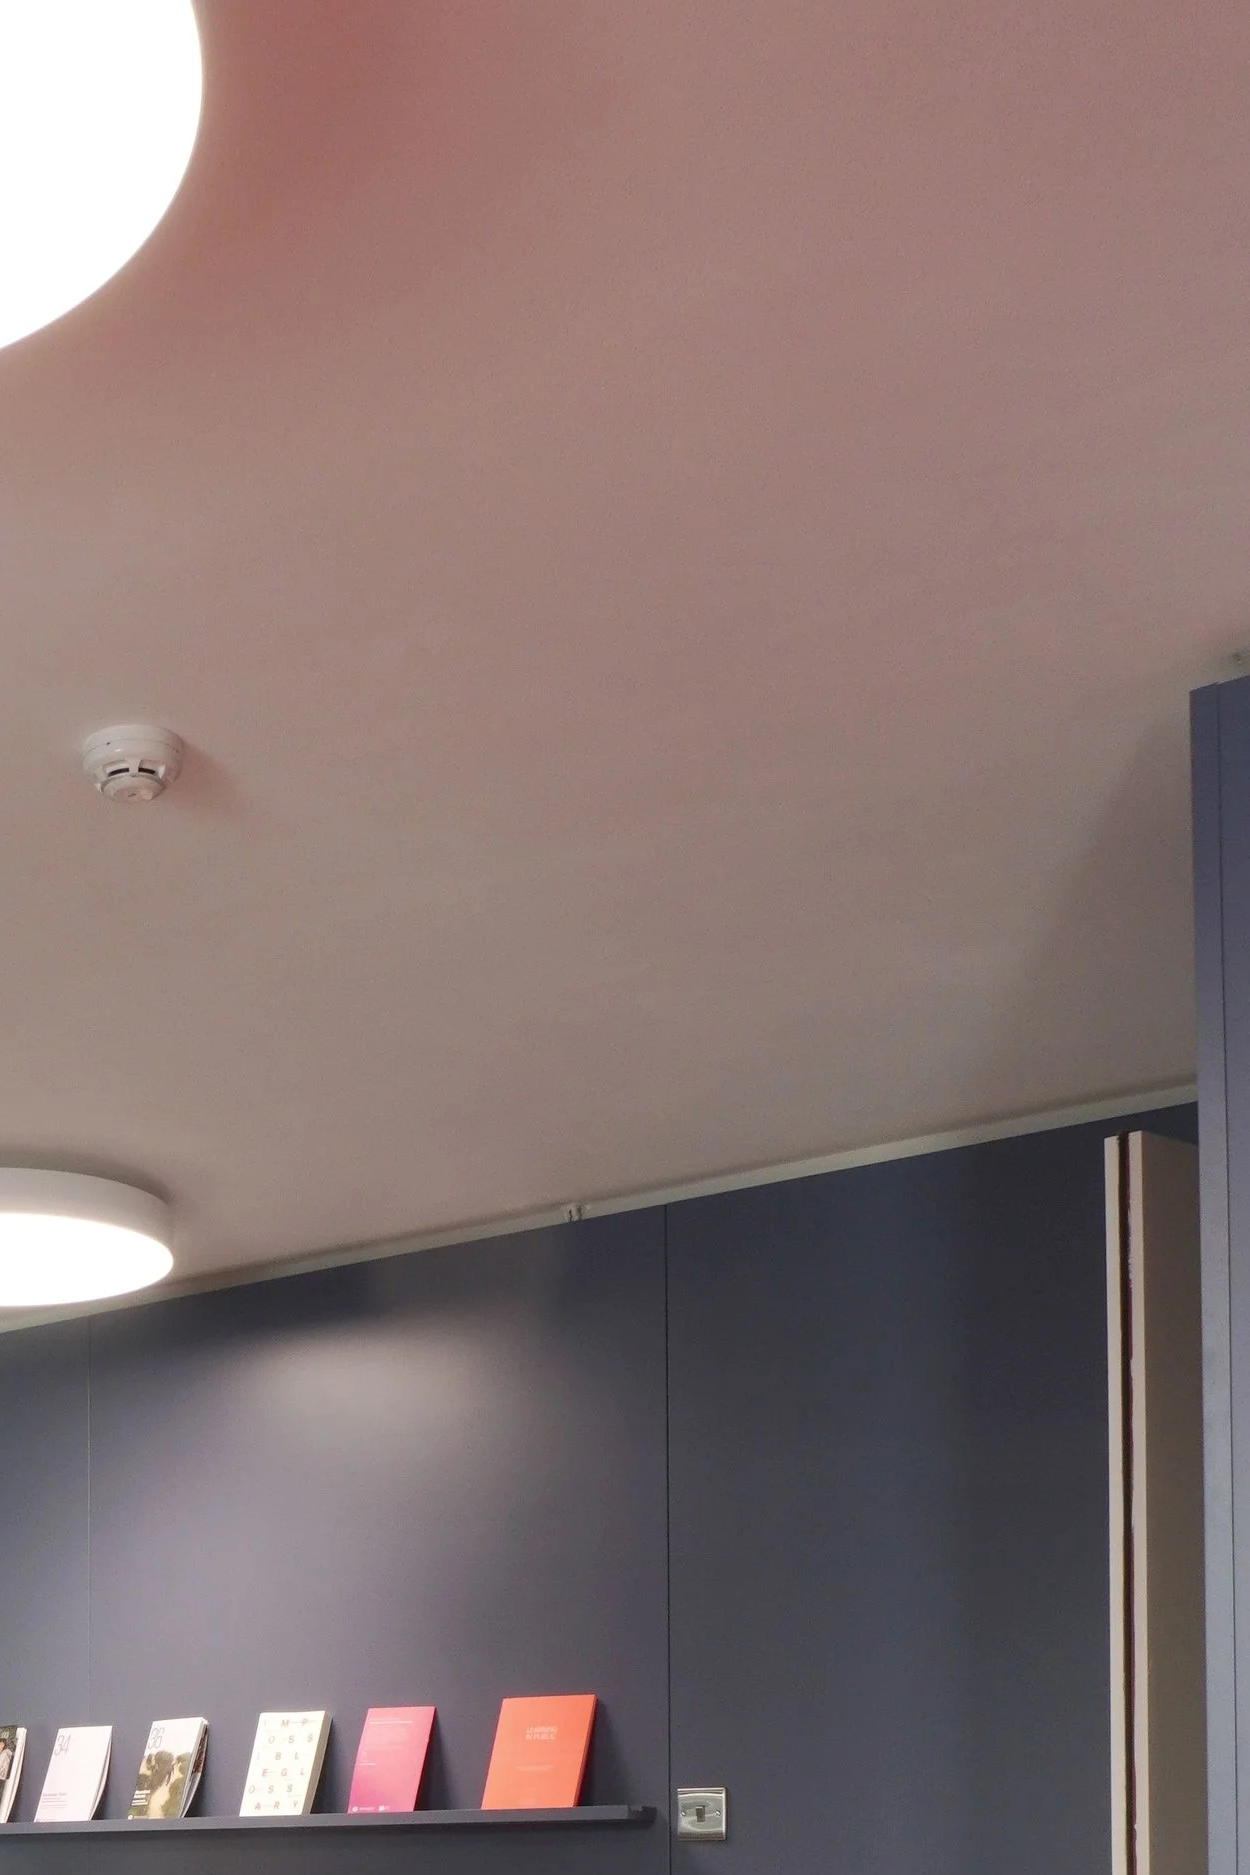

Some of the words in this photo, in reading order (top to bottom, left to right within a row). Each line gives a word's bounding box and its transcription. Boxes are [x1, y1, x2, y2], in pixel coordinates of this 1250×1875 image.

[526, 1725, 558, 1734] LEARNING
[524, 1732, 534, 1740] IN
[536, 1732, 557, 1740] PUBLIC
[54, 1734, 70, 1756] 34
